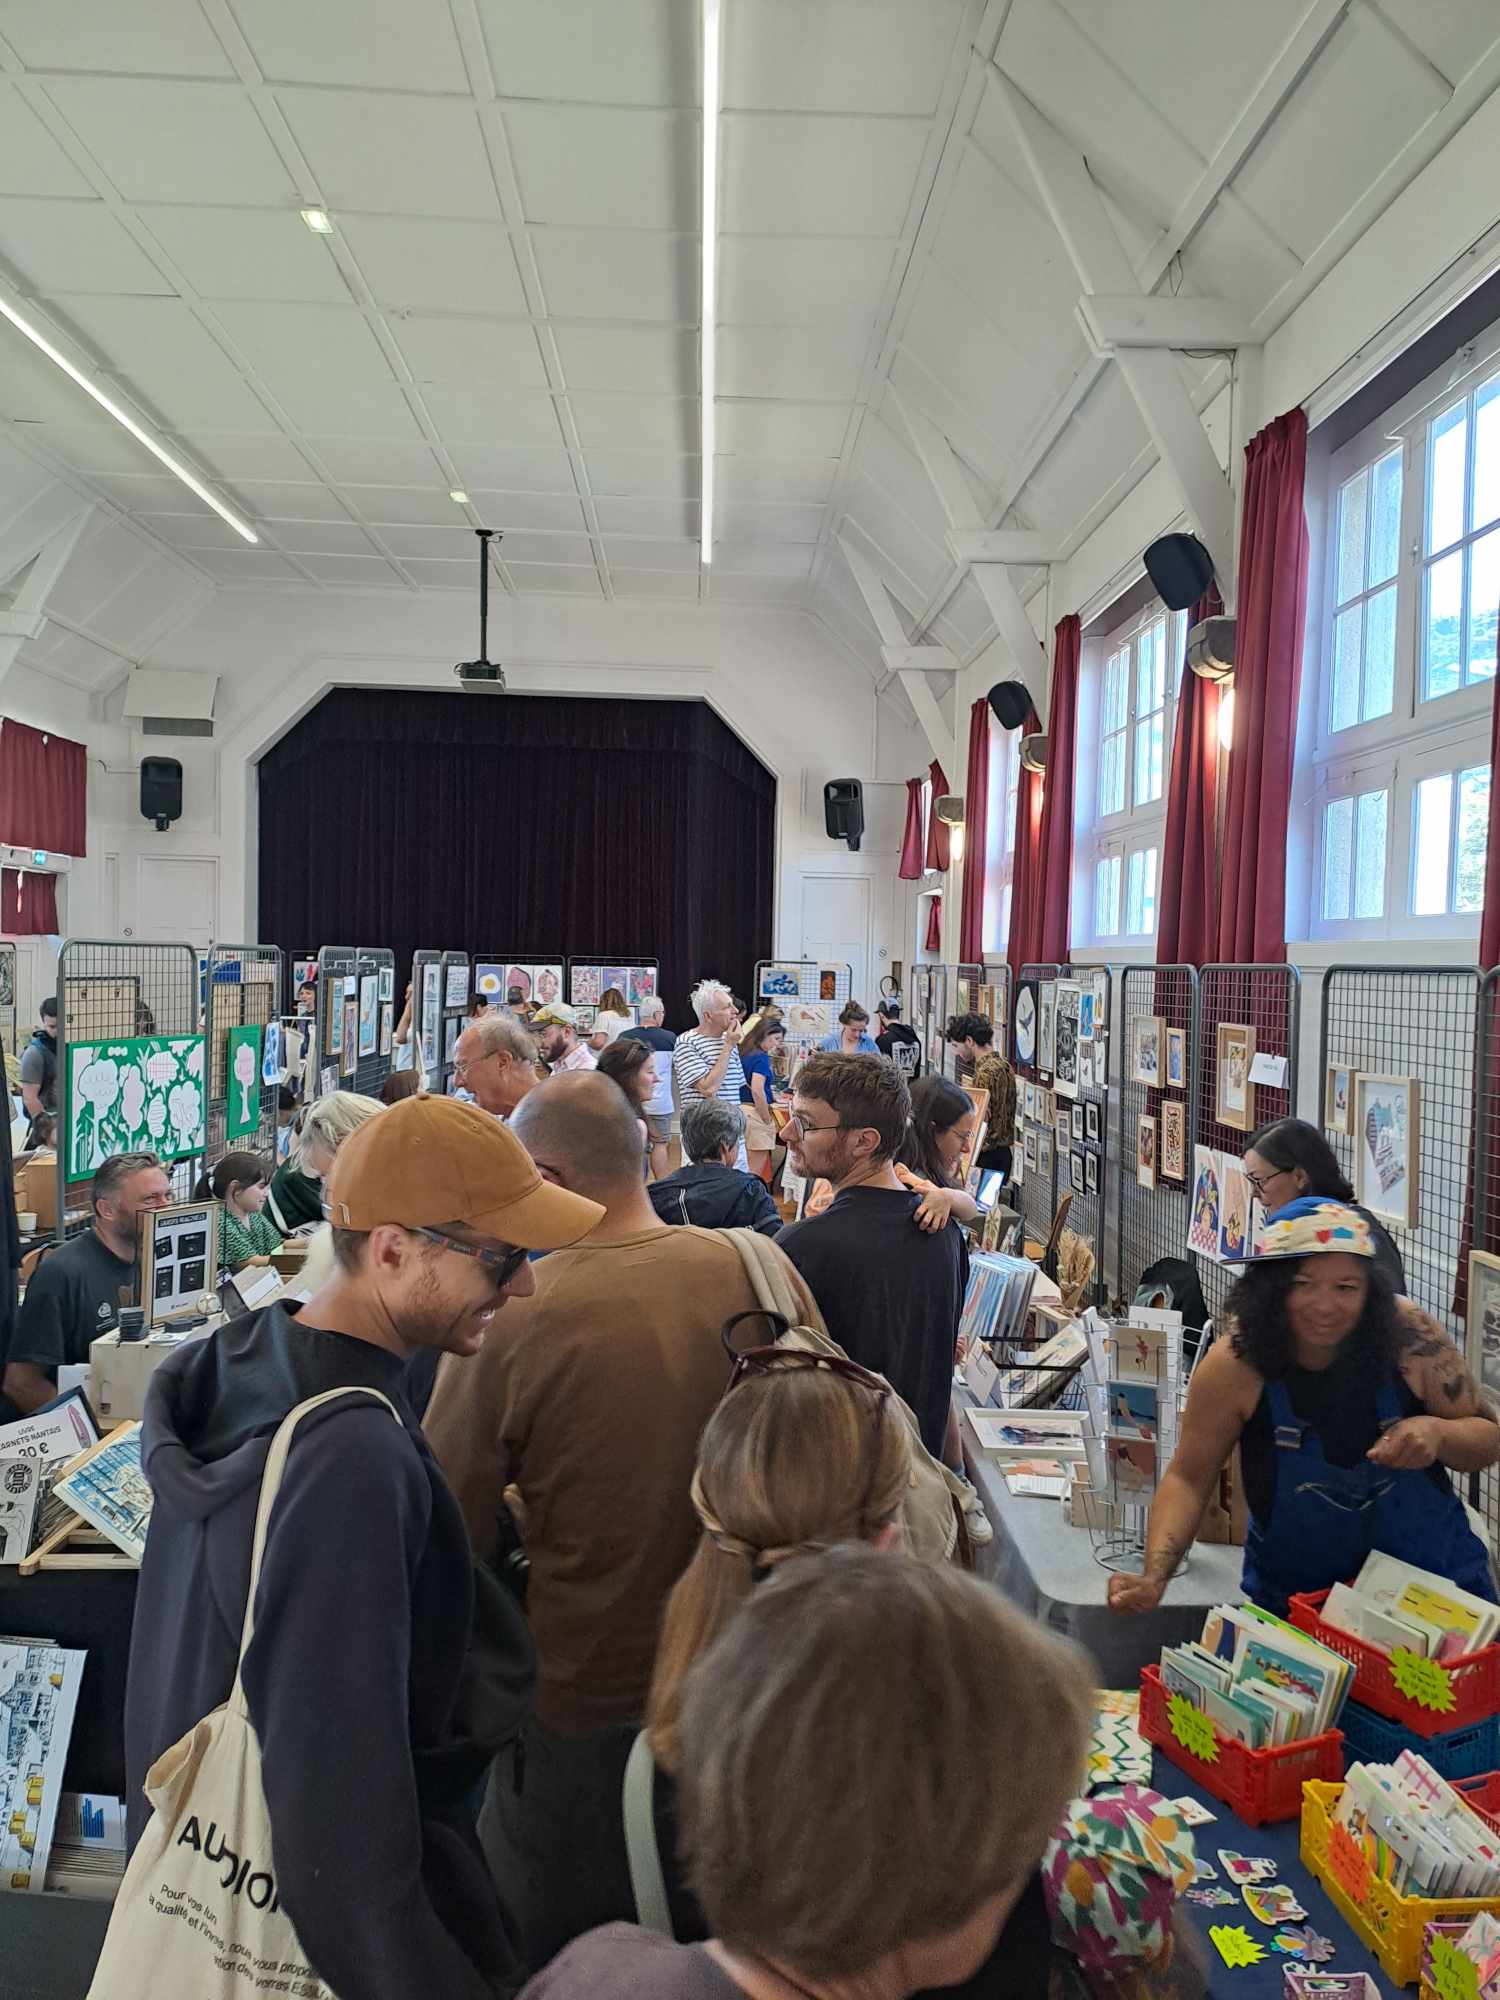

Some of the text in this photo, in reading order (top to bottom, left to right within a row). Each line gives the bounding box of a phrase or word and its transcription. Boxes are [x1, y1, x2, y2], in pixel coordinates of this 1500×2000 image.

[0, 1435, 30, 1451] ARNETS
[39, 1442, 49, 1454] €
[160, 1884, 187, 1901] Pour
